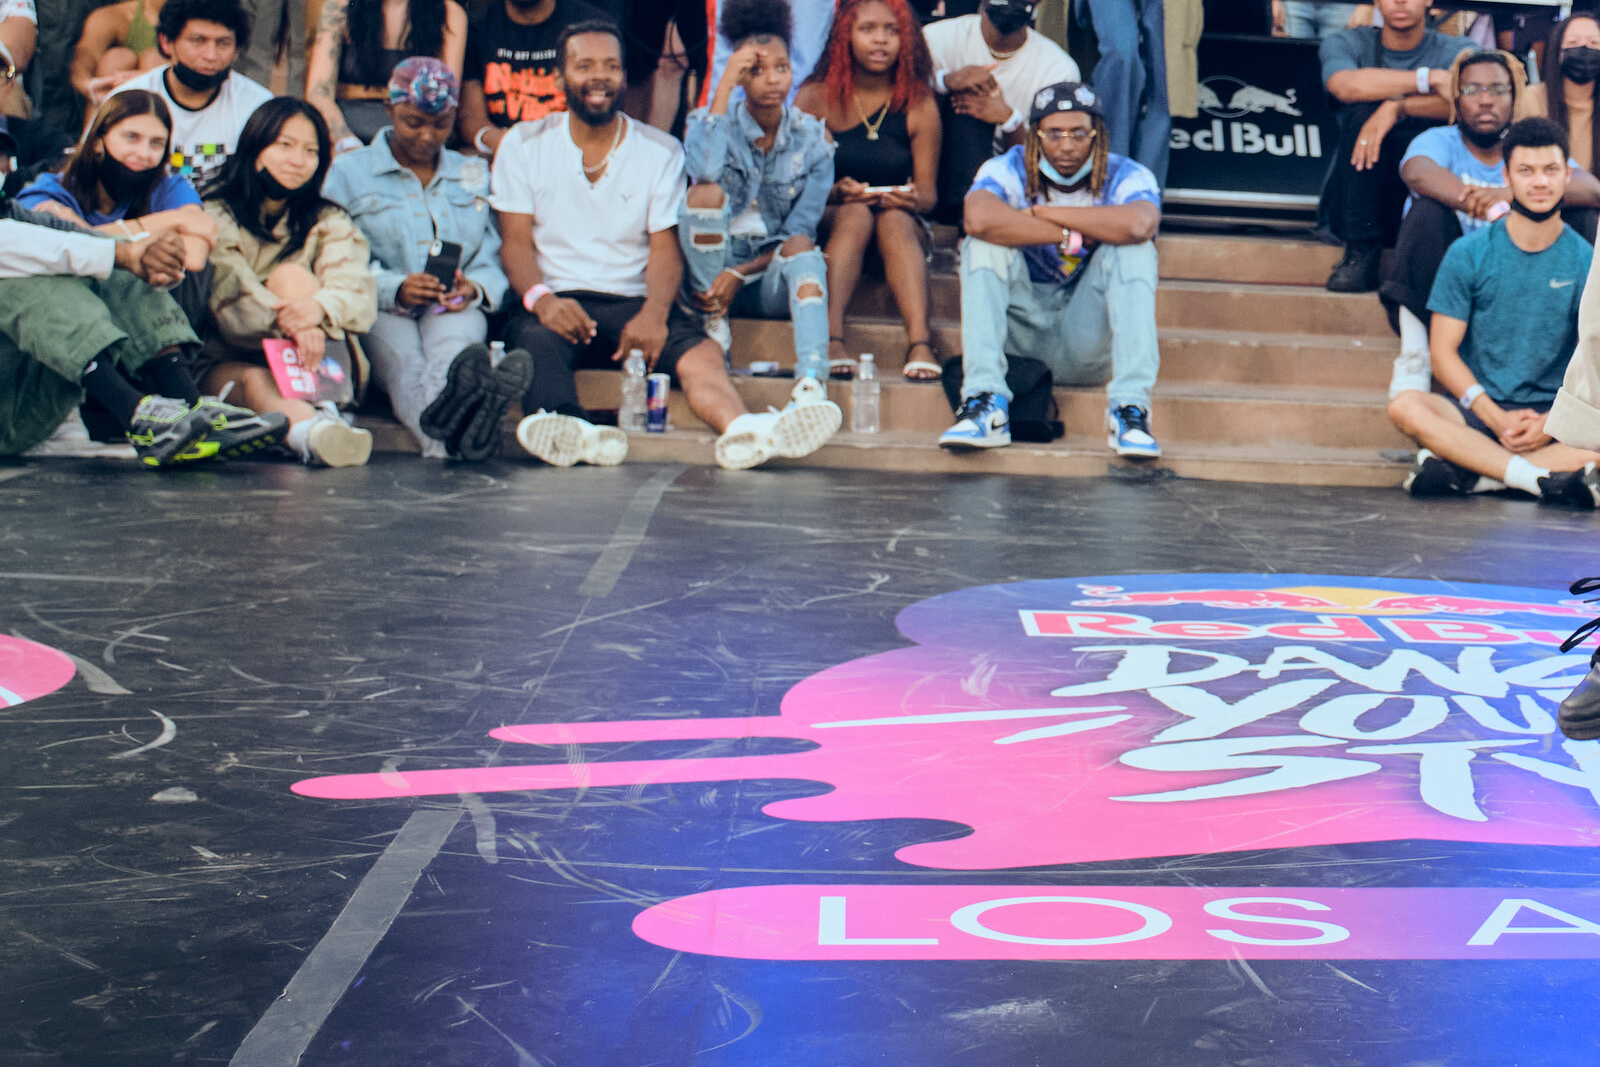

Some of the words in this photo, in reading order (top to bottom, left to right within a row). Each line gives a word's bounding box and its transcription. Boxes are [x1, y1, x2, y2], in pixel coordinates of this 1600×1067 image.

[1169, 119, 1225, 152] ed
[1230, 122, 1323, 158] Bull
[1020, 610, 1384, 642] Red
[819, 895, 1351, 947] LOS
